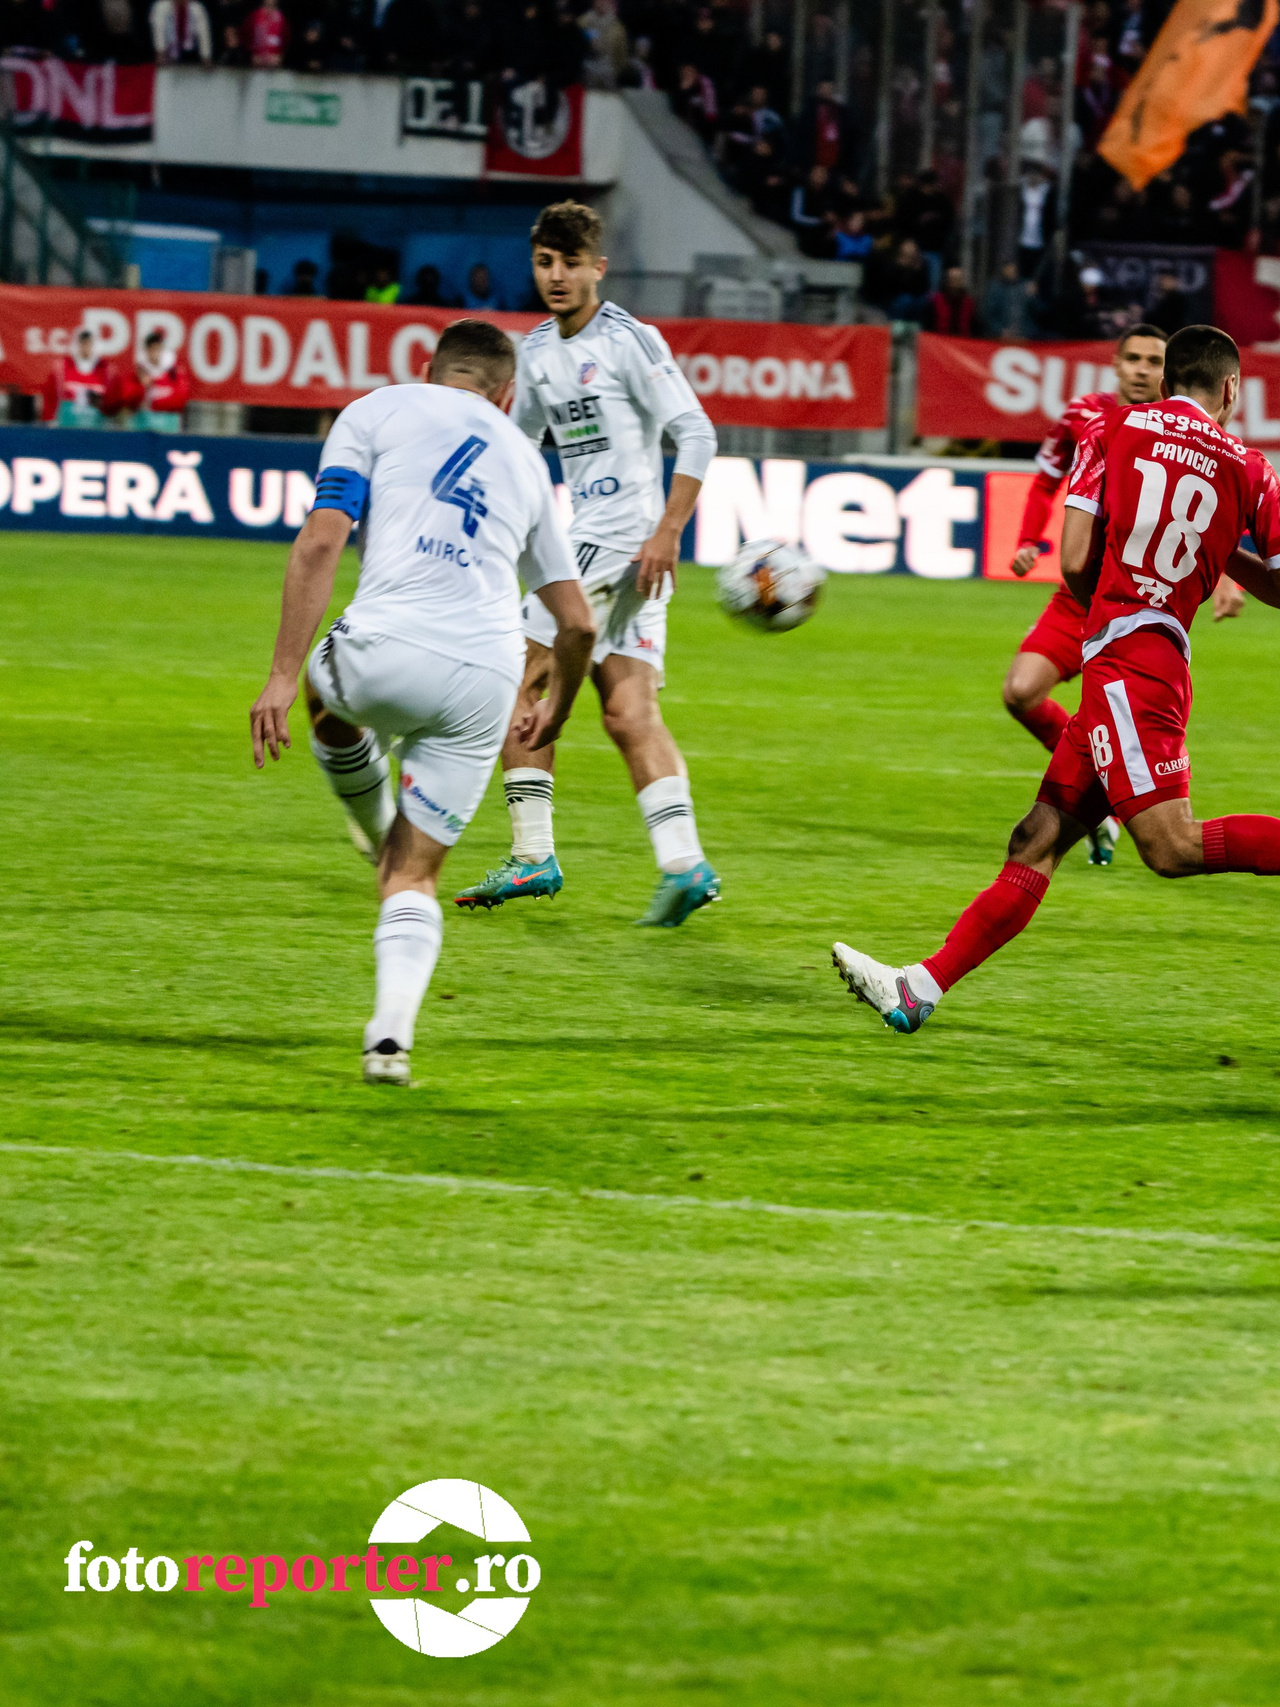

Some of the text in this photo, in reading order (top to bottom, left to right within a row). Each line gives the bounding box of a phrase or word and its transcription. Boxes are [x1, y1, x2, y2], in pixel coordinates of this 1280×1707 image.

[431, 434, 489, 539] 4
[1151, 441, 1218, 479] PAVICIC
[1121, 457, 1219, 584] 18
